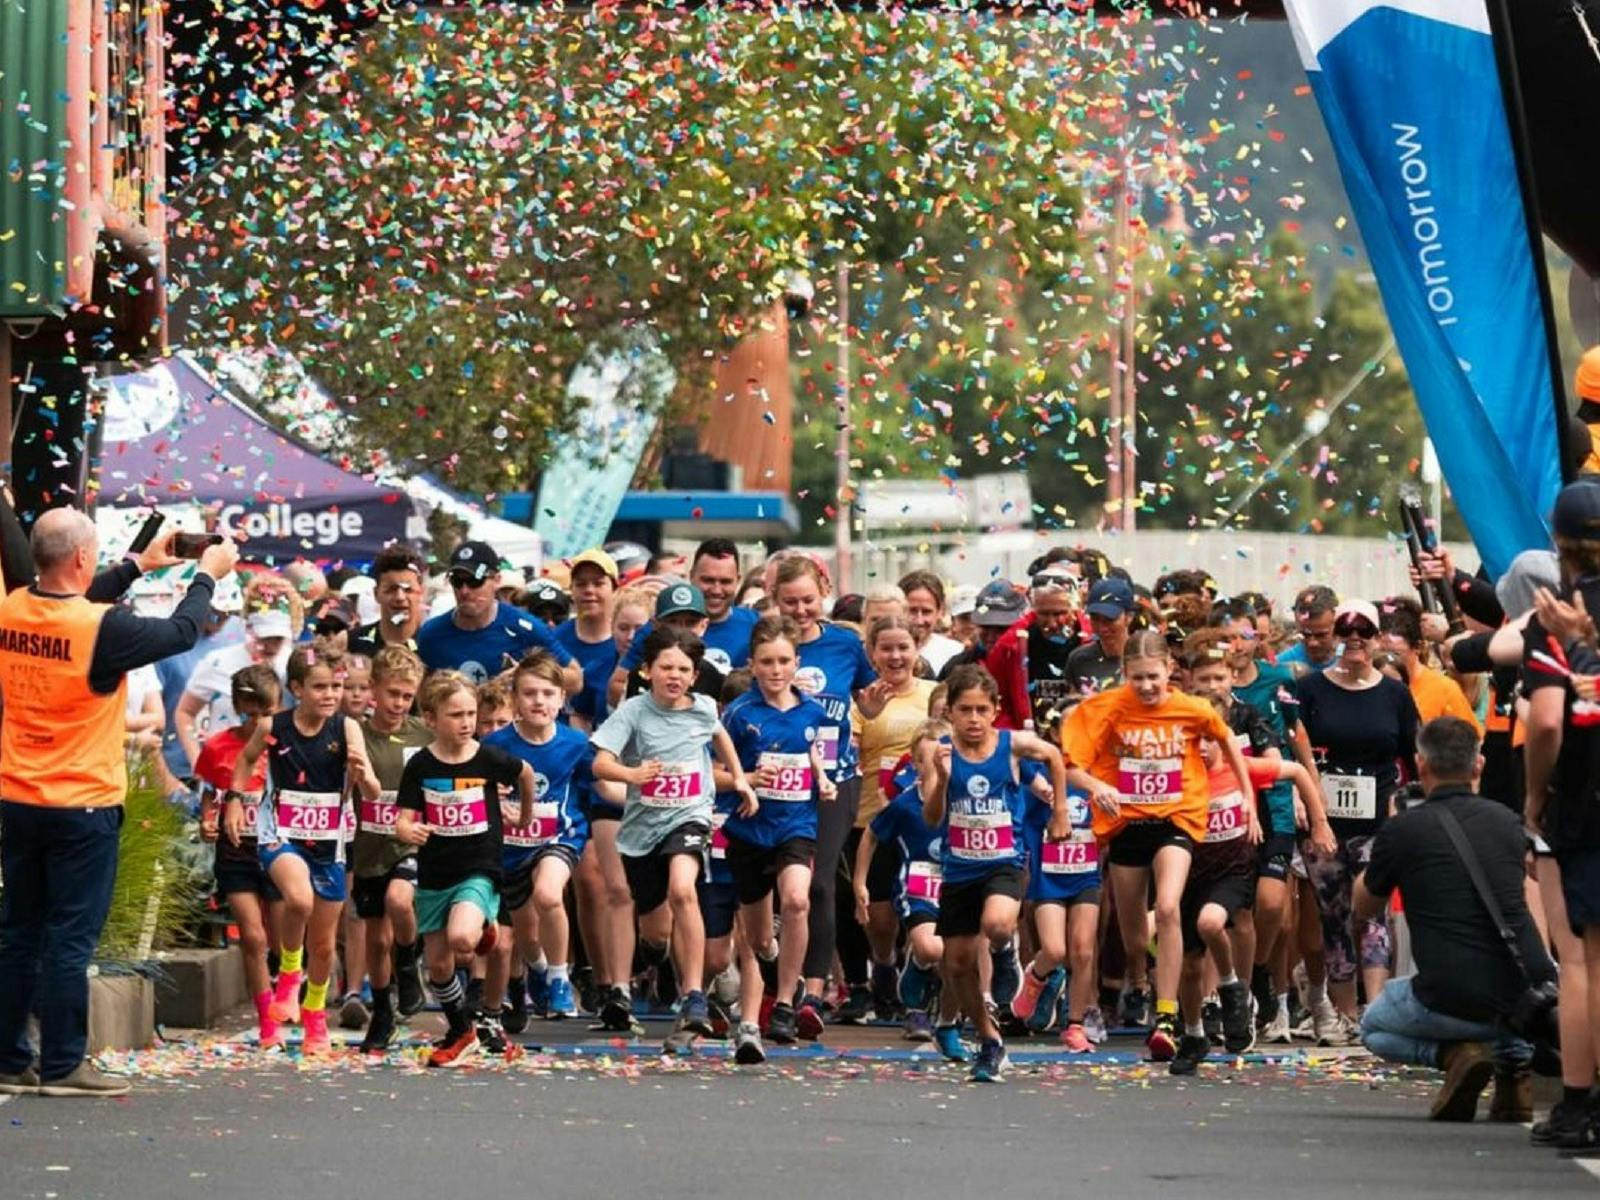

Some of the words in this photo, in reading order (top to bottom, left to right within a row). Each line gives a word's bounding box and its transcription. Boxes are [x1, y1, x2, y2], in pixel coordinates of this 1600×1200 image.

[219, 504, 363, 545] College
[1121, 724, 1184, 745] WALK
[653, 774, 692, 798] 237
[1132, 773, 1168, 795] 169
[1336, 789, 1358, 808] 111
[289, 807, 330, 829] 208
[435, 804, 474, 826] 196
[1209, 808, 1236, 834] 40
[961, 829, 999, 850] 180
[1057, 843, 1087, 865] 173
[924, 878, 943, 900] 17
